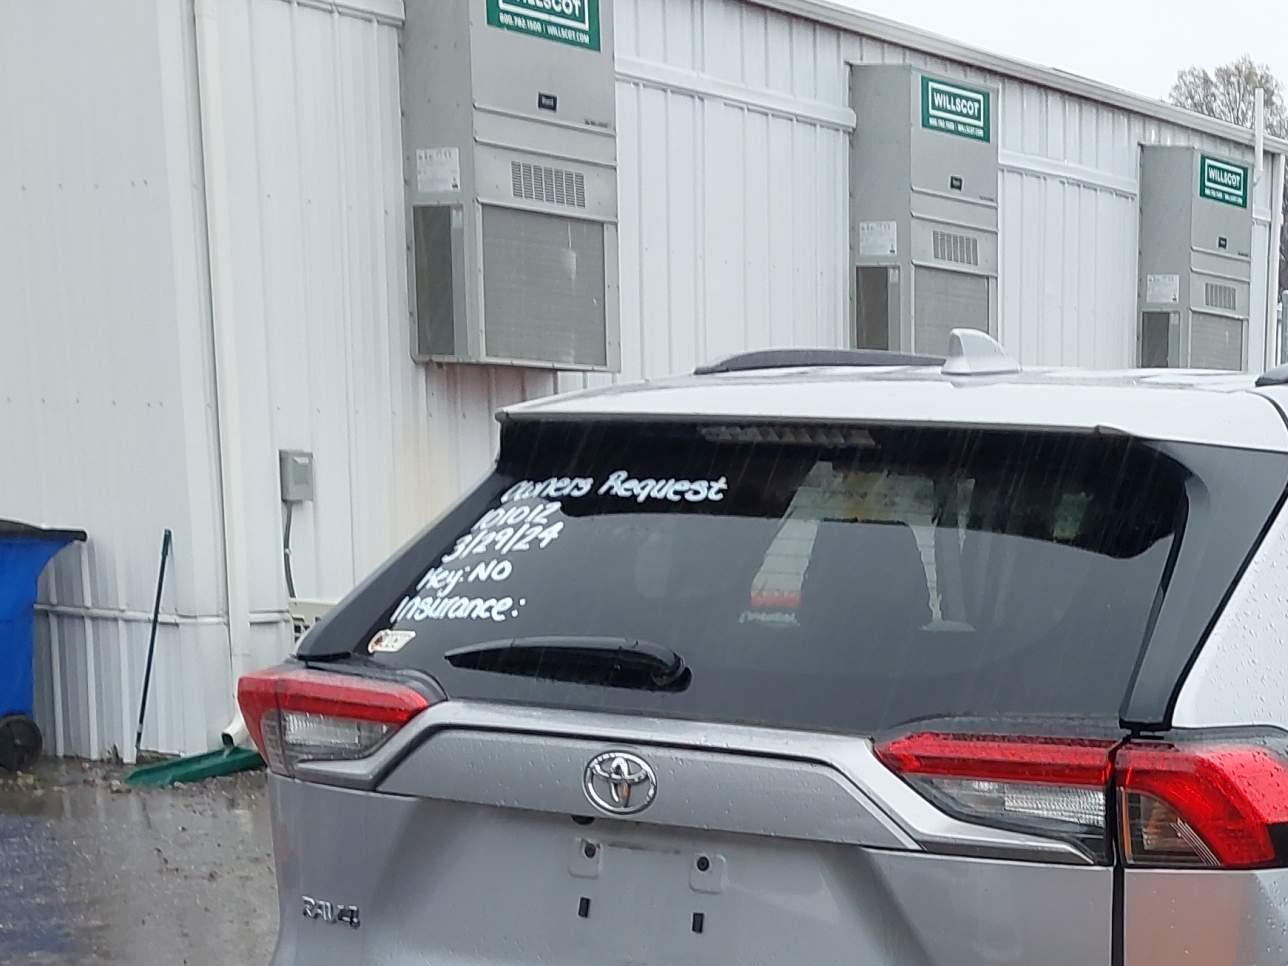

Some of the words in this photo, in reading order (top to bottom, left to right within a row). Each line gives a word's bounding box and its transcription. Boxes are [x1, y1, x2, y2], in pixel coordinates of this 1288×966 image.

[933, 91, 979, 117] WILLSCOT
[1208, 167, 1241, 189] WILLSCOT
[598, 470, 728, 503] Request
[441, 521, 564, 563] 3/29/24
[468, 559, 512, 581] NO
[390, 596, 526, 623] Insurance:
[302, 895, 360, 929] RAV4
